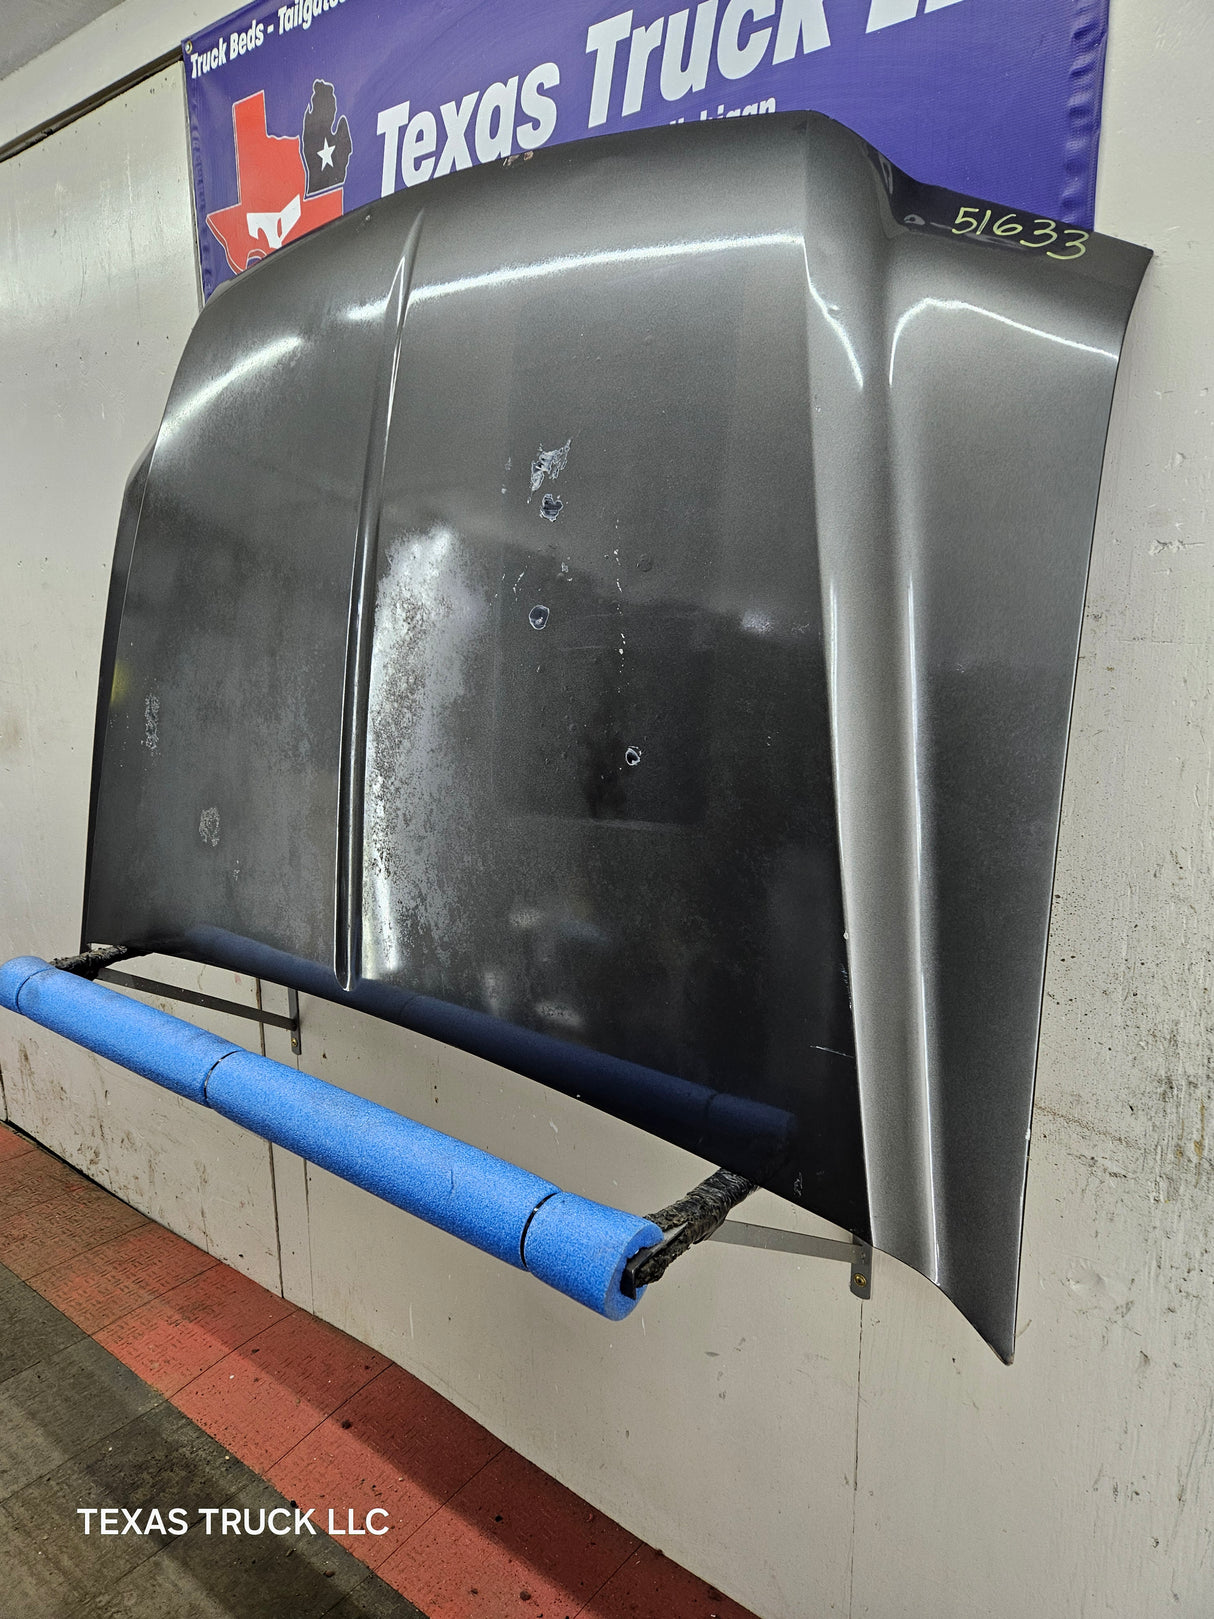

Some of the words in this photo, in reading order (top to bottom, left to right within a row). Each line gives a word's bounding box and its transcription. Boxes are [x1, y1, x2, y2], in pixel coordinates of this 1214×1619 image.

[191, 38, 227, 79] Truck
[230, 19, 264, 60] Beds
[377, 62, 560, 198] Texas
[952, 206, 1089, 260] 51633
